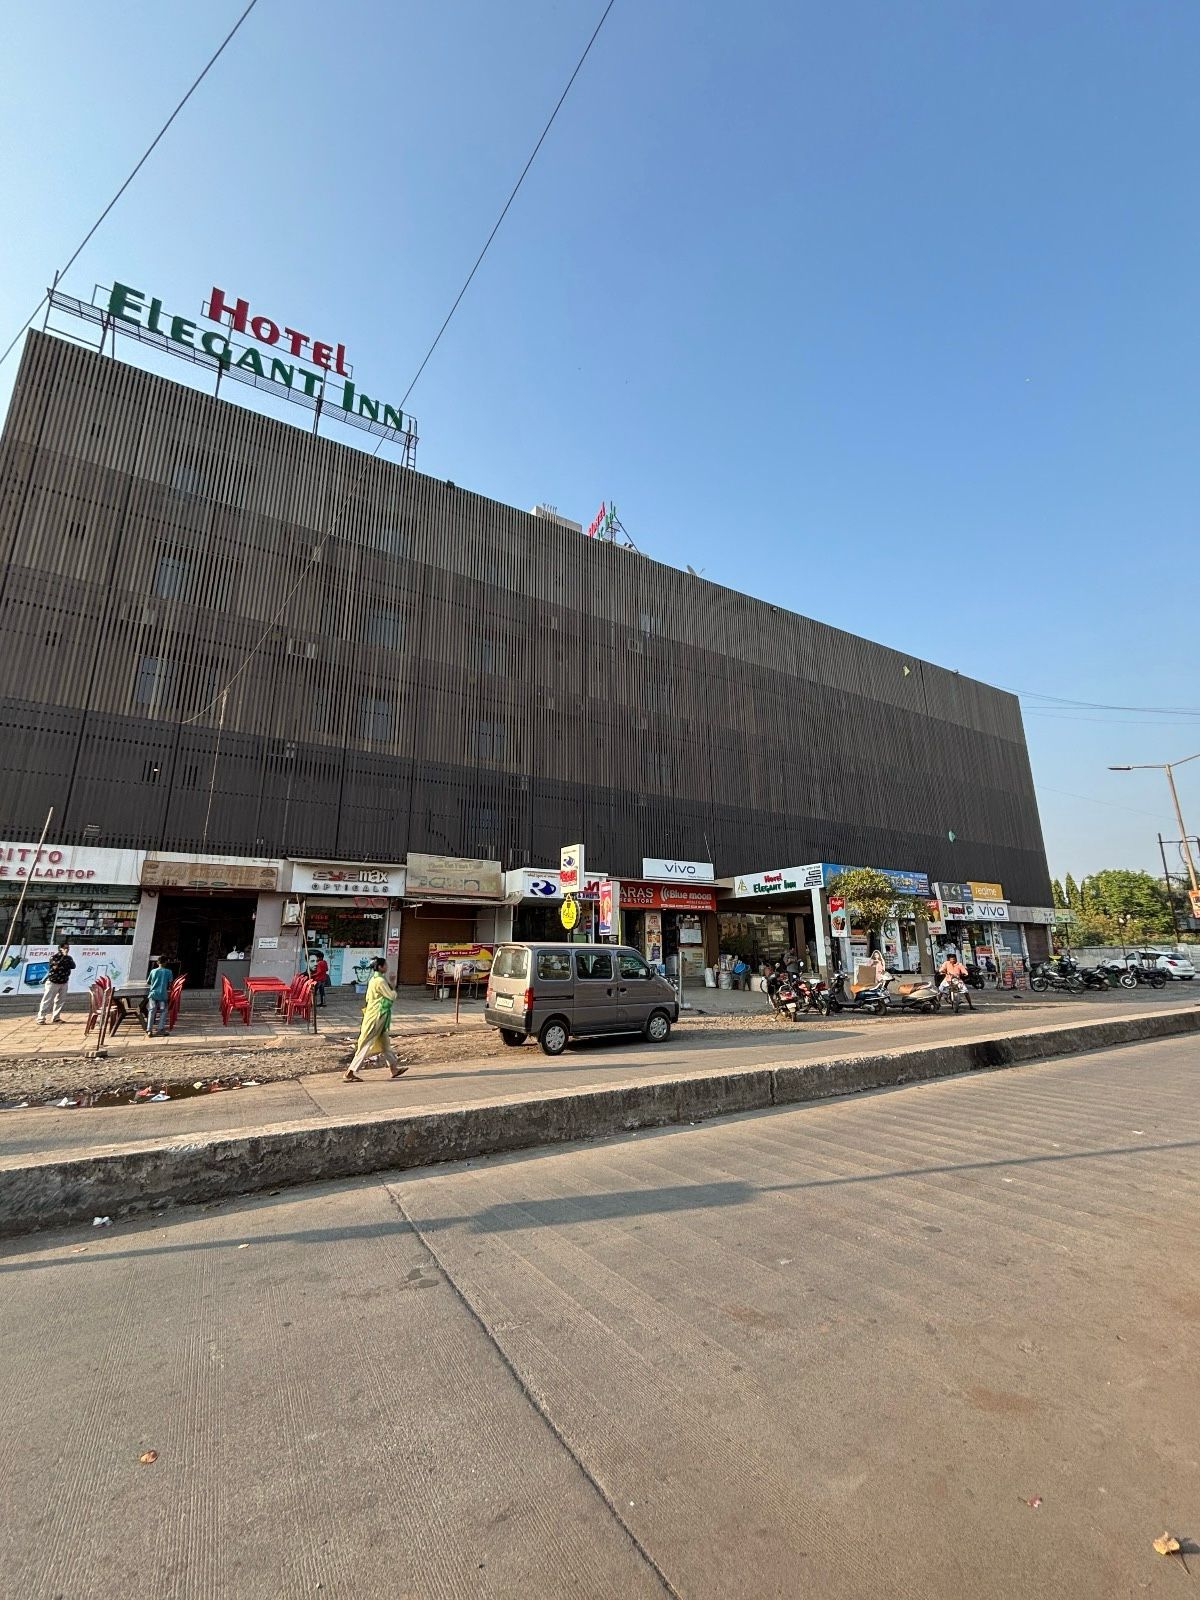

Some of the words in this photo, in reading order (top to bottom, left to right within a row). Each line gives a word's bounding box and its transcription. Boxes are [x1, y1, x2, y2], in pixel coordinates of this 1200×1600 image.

[343, 380, 403, 430] INN
[16, 866, 26, 876] &
[34, 867, 96, 879] LAPTOP
[665, 862, 696, 874] vivo
[312, 883, 389, 893] OPTICALS
[670, 889, 688, 899] Blue
[689, 892, 712, 901] moon
[978, 903, 1005, 916] vivo
